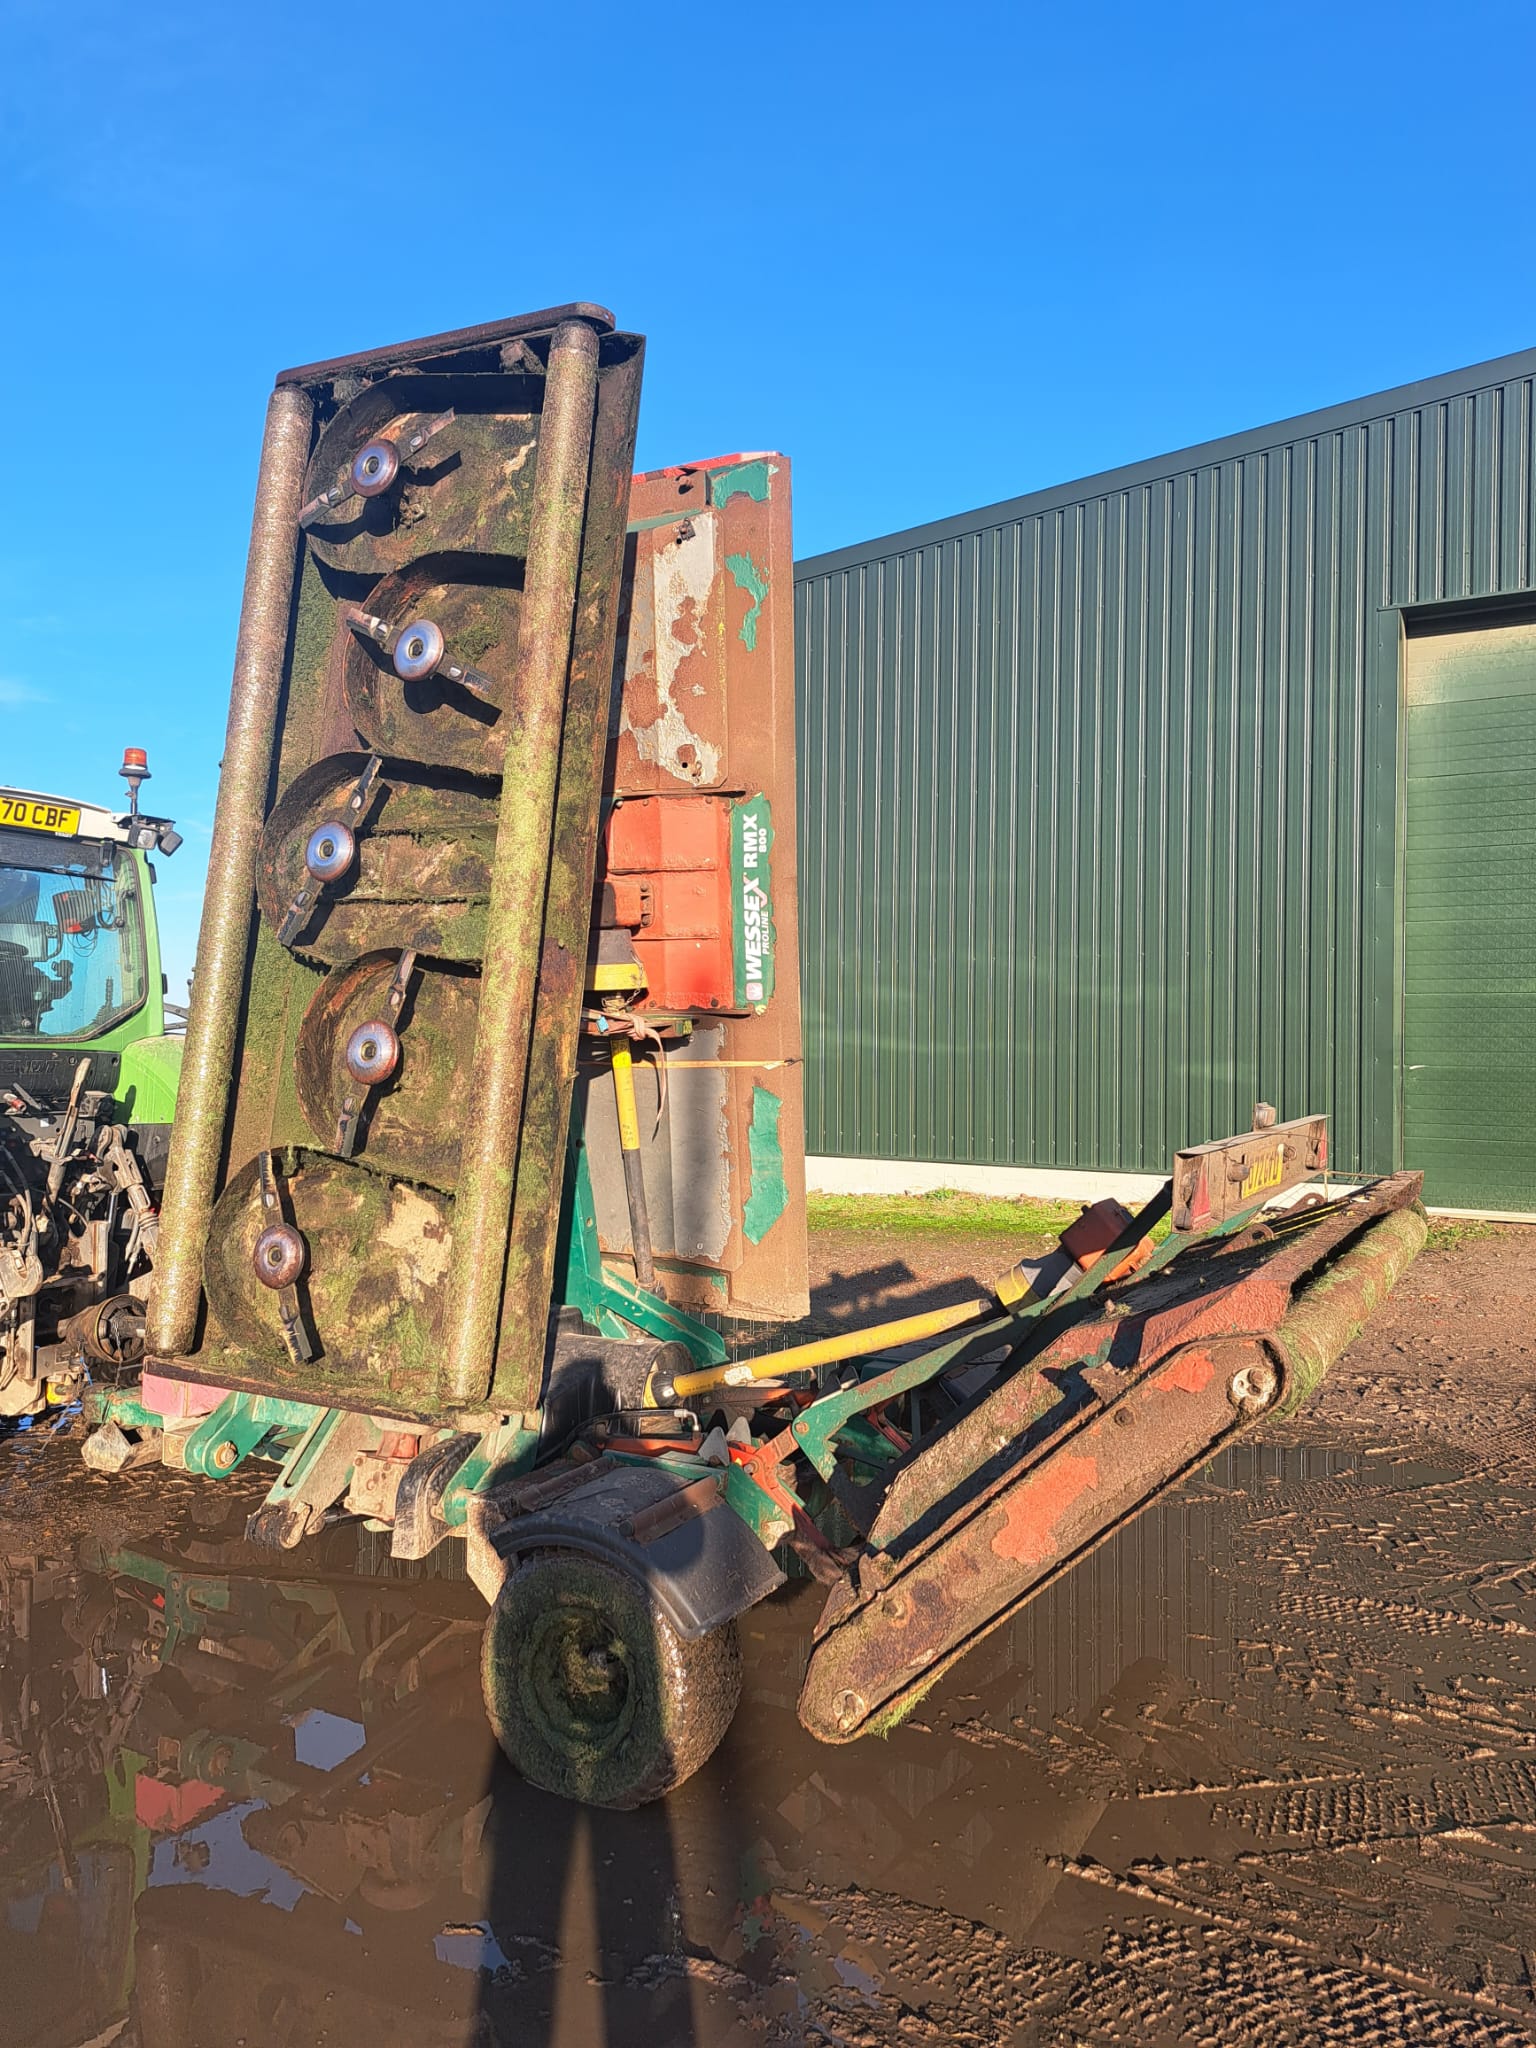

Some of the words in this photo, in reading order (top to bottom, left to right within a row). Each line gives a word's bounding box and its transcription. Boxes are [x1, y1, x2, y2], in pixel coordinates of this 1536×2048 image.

[32, 806, 71, 828] CBF
[743, 814, 758, 868] RMX
[743, 874, 764, 981] WESSEX
[761, 910, 770, 955] PROLINE
